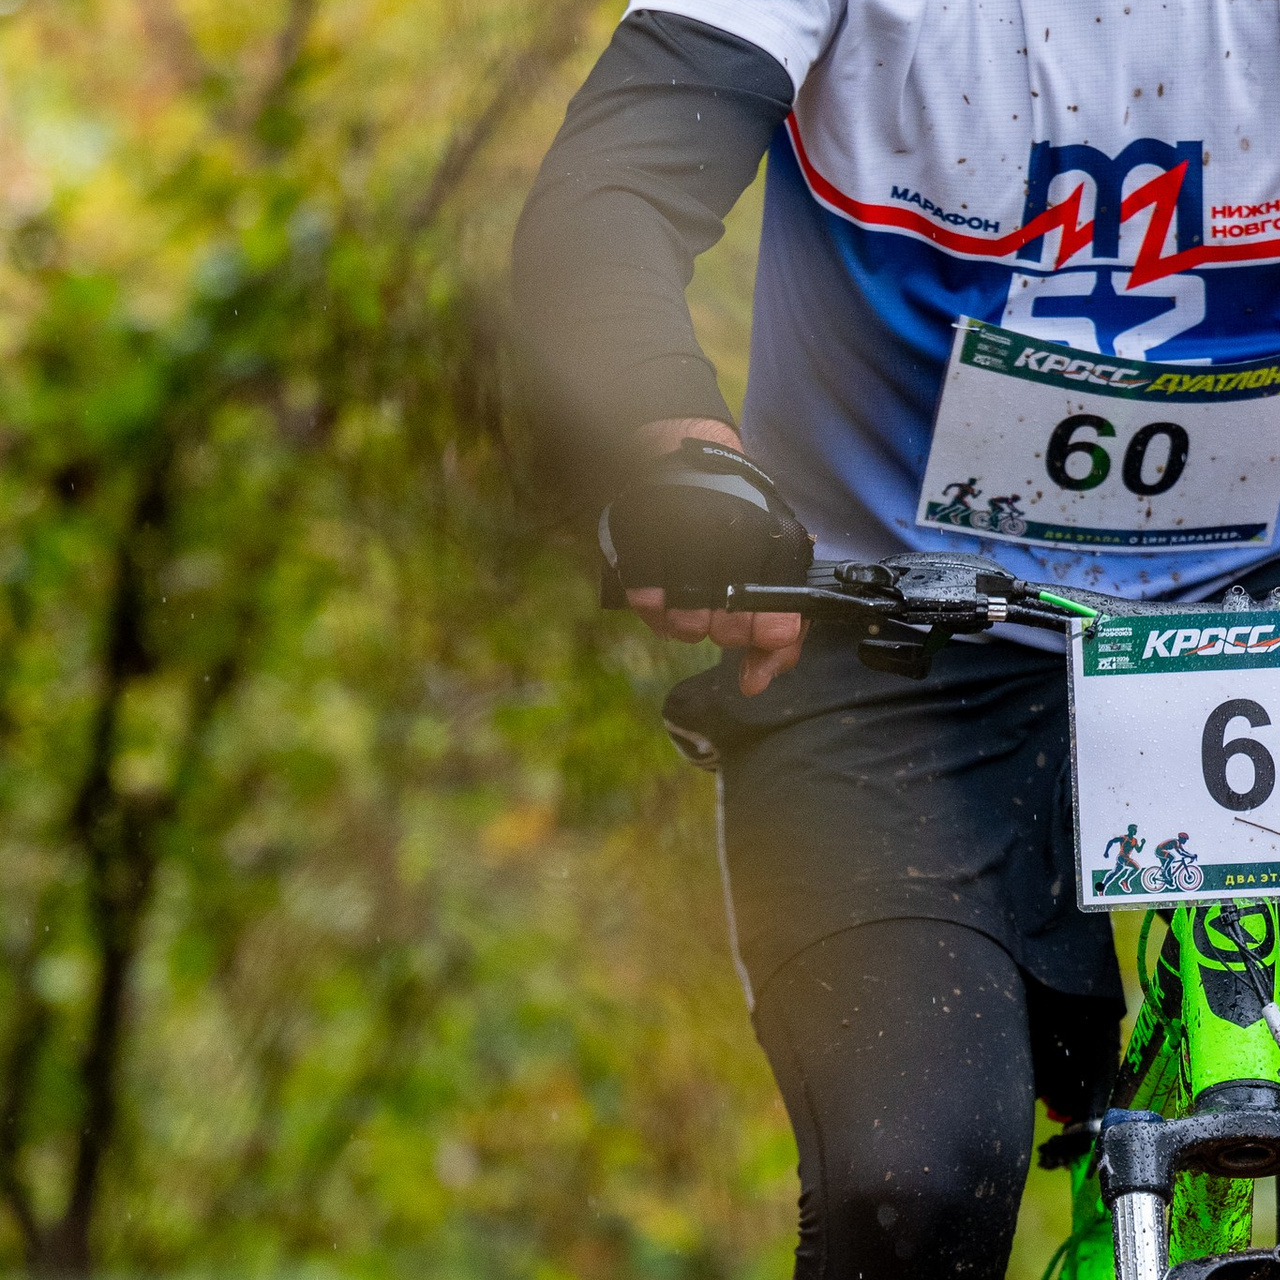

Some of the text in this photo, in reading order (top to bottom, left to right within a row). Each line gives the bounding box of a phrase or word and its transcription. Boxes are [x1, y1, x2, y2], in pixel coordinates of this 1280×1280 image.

[890, 185, 1000, 233] МАРАФОН
[1013, 347, 1149, 389] КРОСС
[1045, 414, 1190, 497] 60
[1043, 530, 1072, 540] ДВА
[1225, 874, 1256, 885] ДВА
